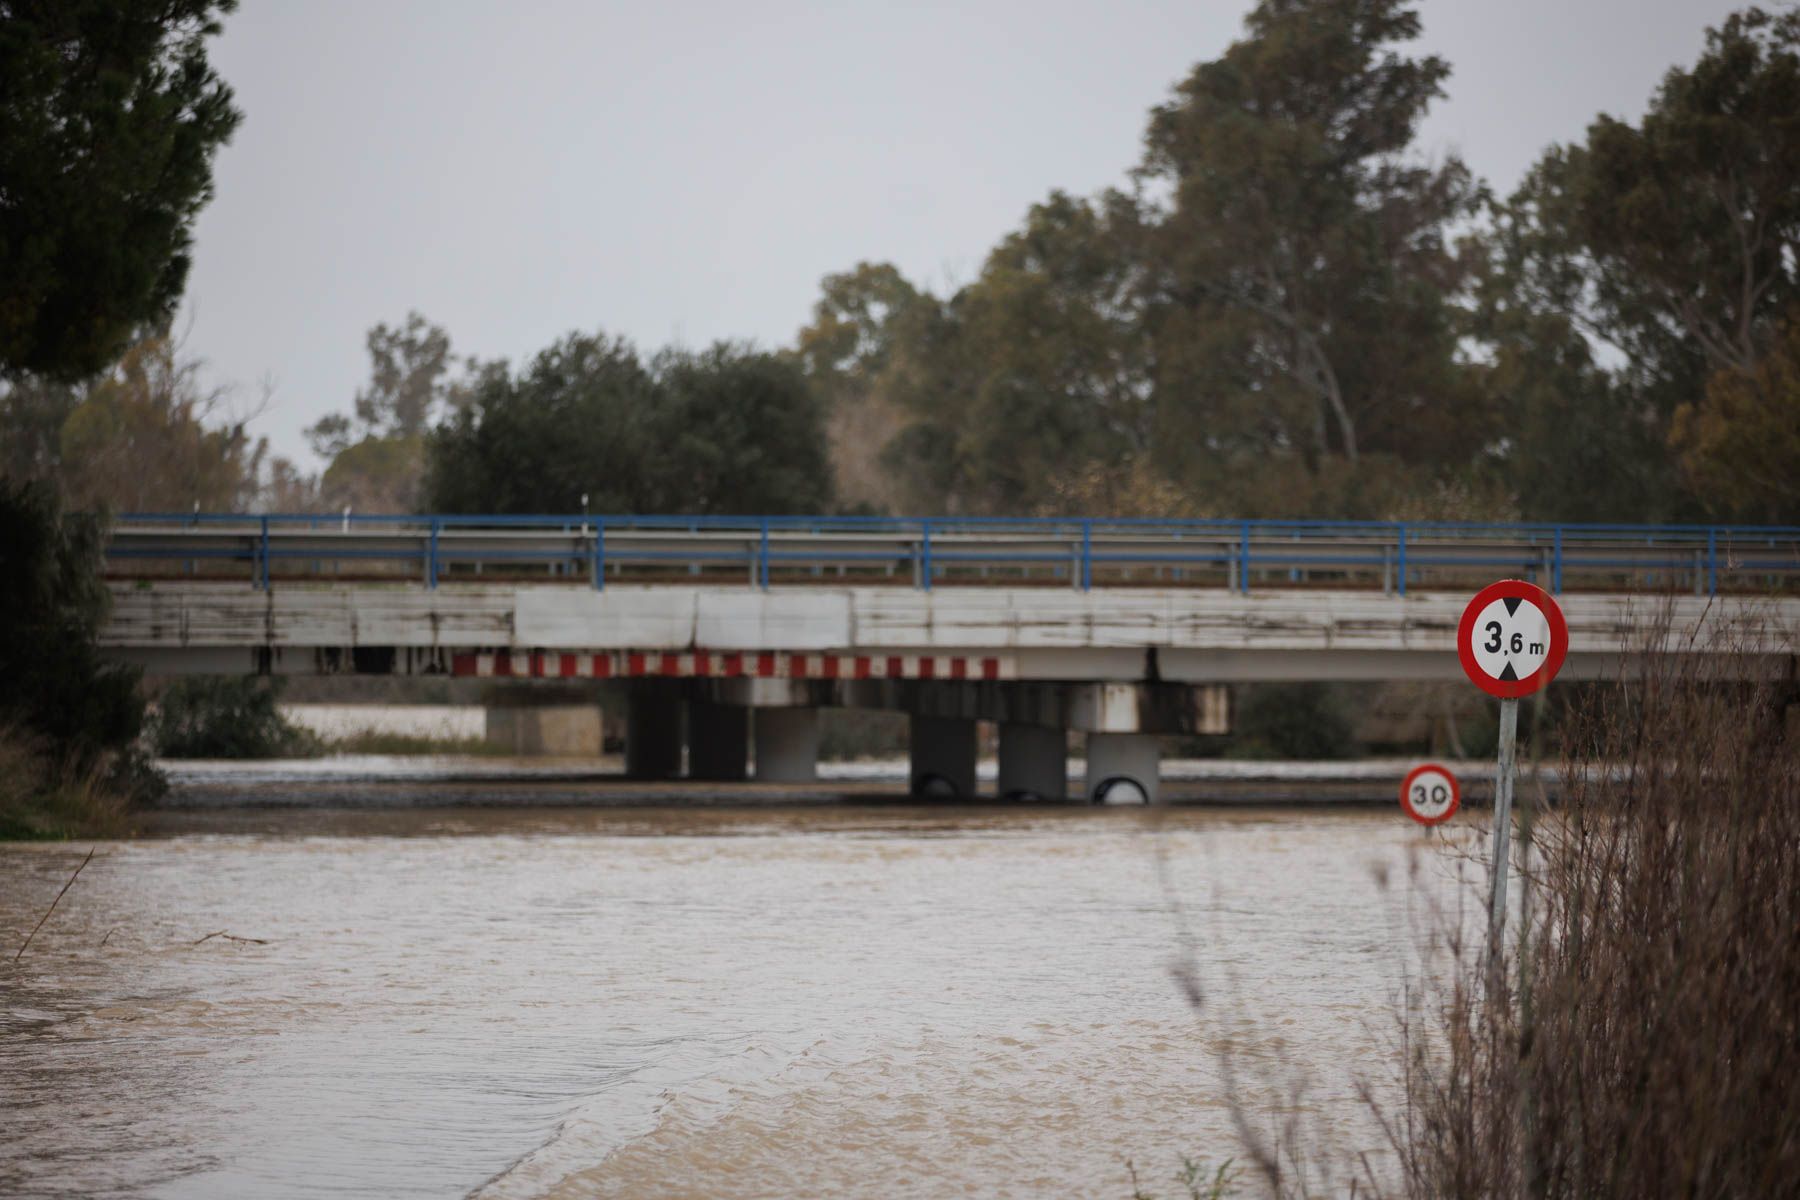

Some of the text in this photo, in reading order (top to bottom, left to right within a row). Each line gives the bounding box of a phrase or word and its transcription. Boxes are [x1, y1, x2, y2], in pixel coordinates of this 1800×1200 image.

[1484, 621, 1545, 656] 3,6 m
[1413, 784, 1447, 805] 30
